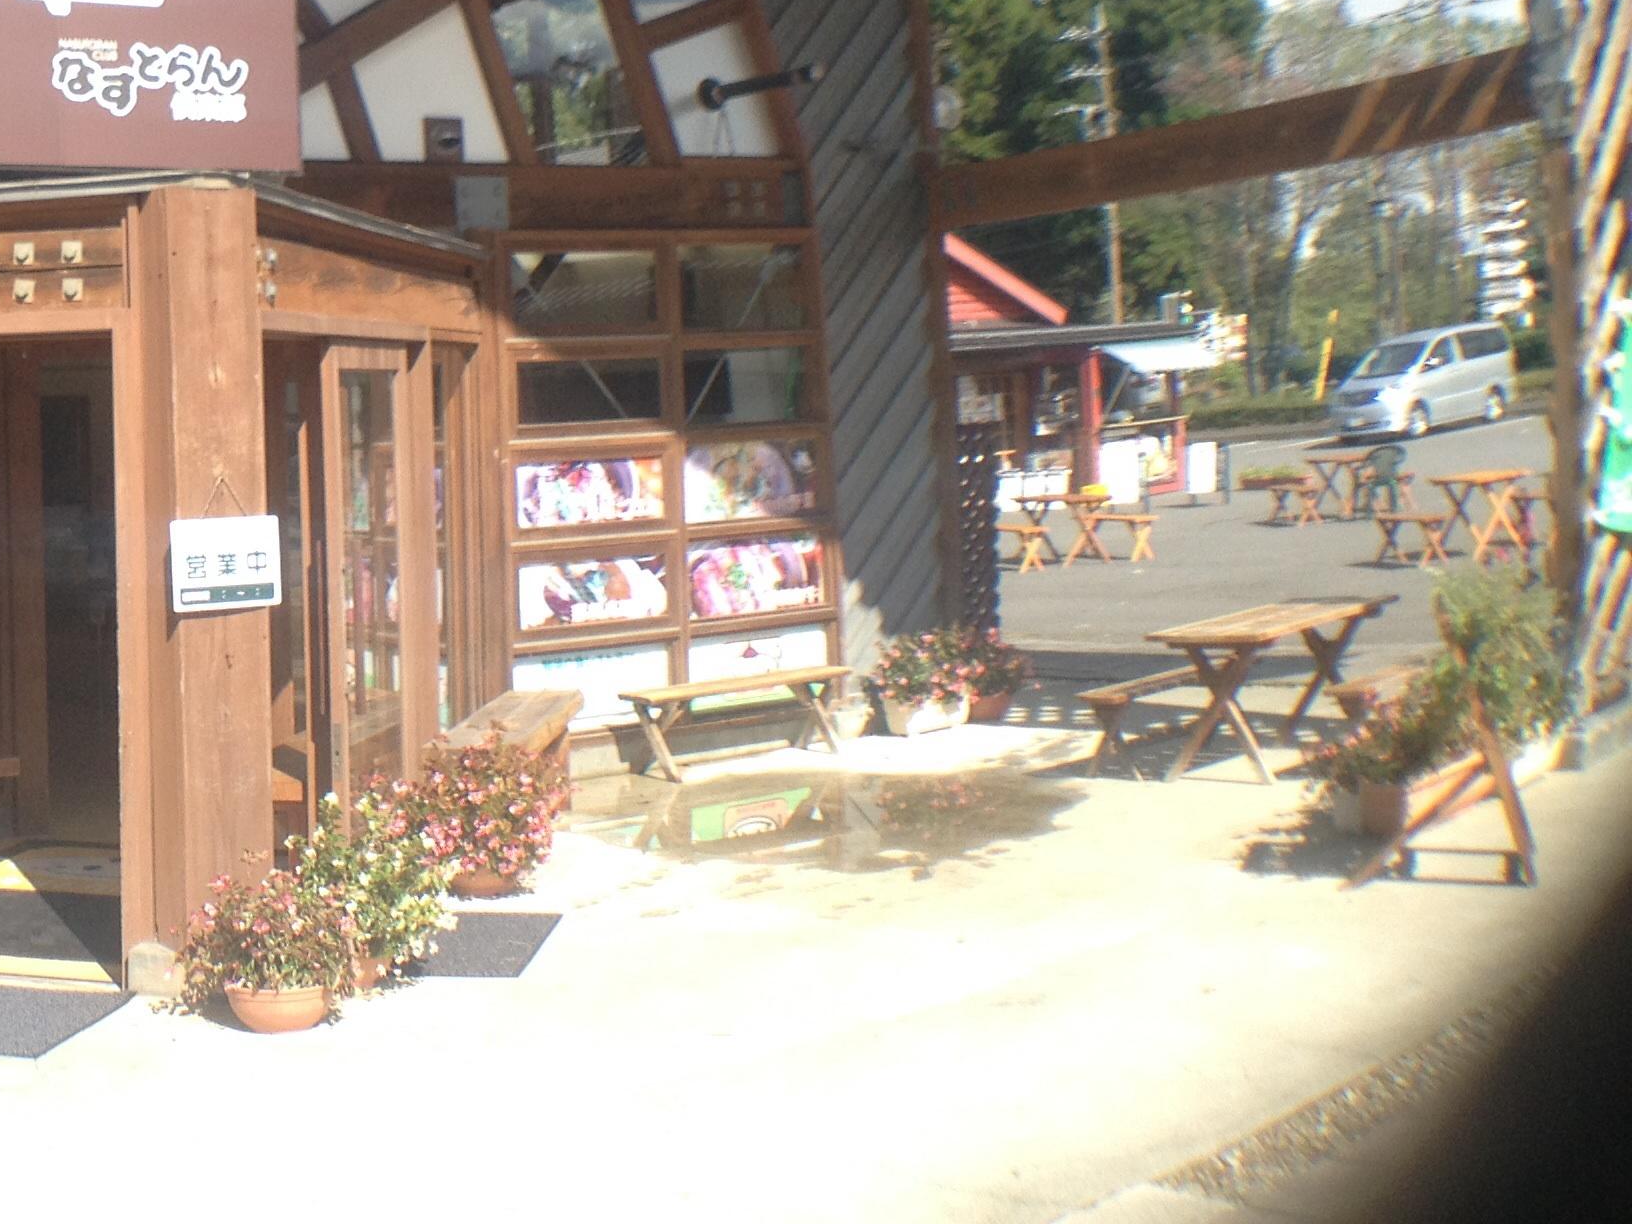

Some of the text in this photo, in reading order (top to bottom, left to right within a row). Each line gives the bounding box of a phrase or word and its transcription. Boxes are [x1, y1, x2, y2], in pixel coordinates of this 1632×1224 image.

[54, 45, 246, 114] なすとらん
[186, 551, 267, 579] 営業中
